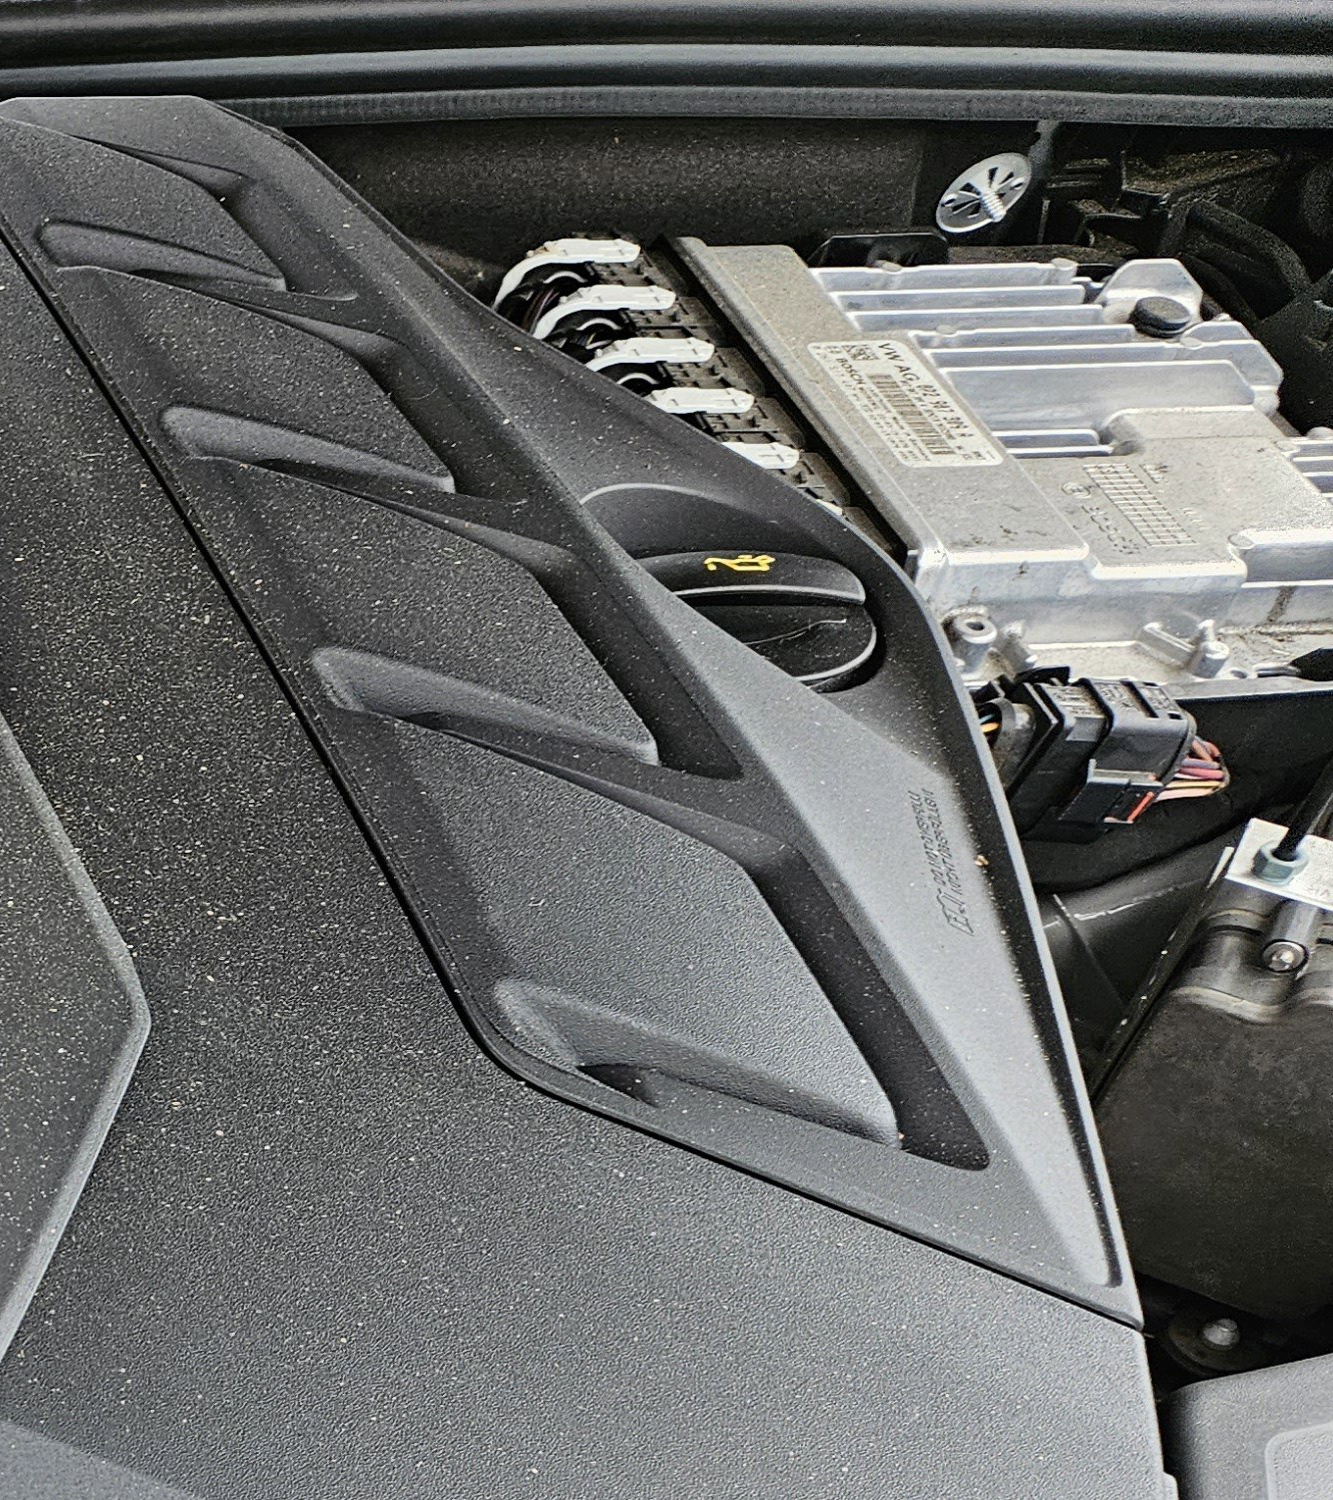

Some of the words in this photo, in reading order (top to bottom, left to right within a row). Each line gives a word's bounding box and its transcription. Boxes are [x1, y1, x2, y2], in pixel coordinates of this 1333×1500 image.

[835, 357, 868, 386] BOSCH
[878, 343, 904, 362] VW
[894, 364, 921, 382] AG
